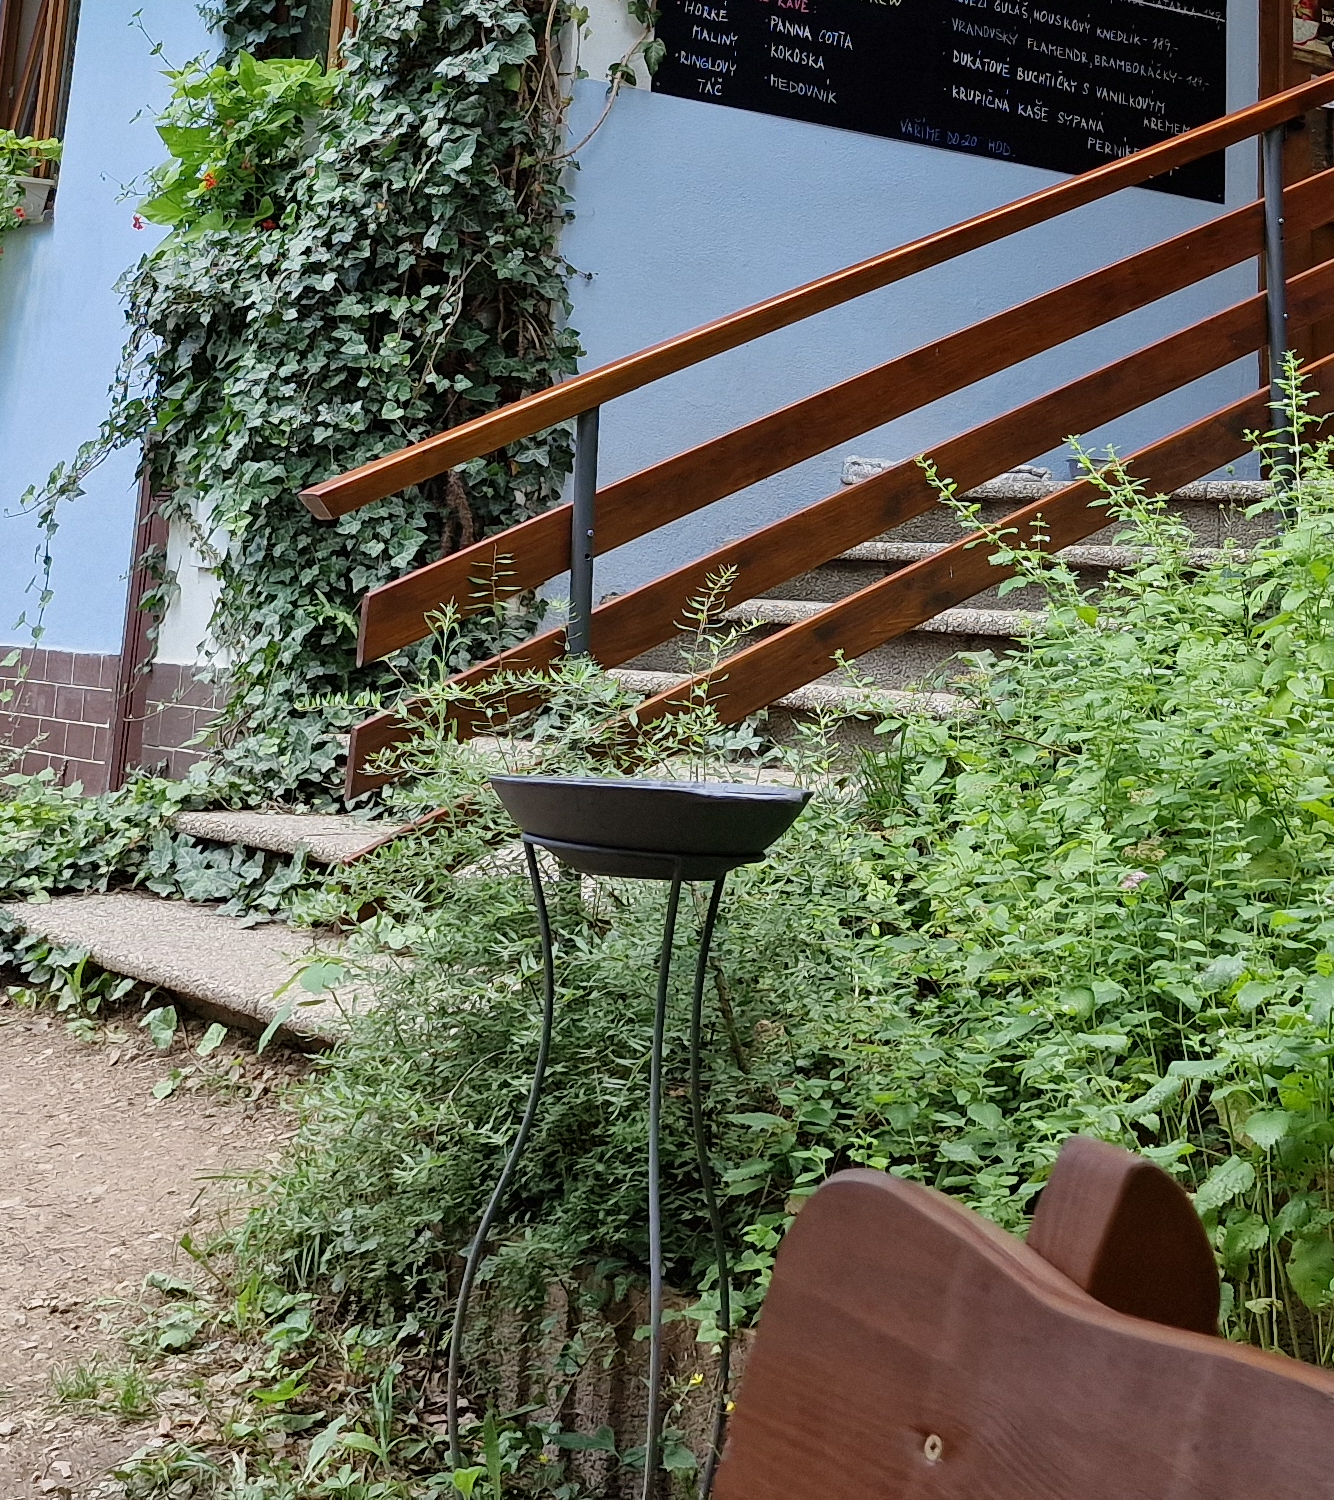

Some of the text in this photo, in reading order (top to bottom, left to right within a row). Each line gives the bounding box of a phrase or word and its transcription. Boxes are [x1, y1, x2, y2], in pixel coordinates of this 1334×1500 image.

[684, 0, 729, 22] HORKÉ
[1033, 8, 1091, 35] HOUSKOVÝ
[692, 24, 738, 46] MALINY
[770, 15, 853, 51] PANNA COTTA
[680, 50, 737, 77] RINGLOVÝ
[770, 42, 825, 71] KOKOSKA
[770, 74, 838, 105] MEDOVNÍK
[953, 49, 1010, 78] DUKÁTOVÉ
[1082, 83, 1089, 95] S
[1096, 85, 1166, 115] VANILKOVÝM
[952, 85, 1105, 133] KRUPIČNÁ KAŠE SYPANÁ
[900, 118, 941, 141] VAŘÍME
